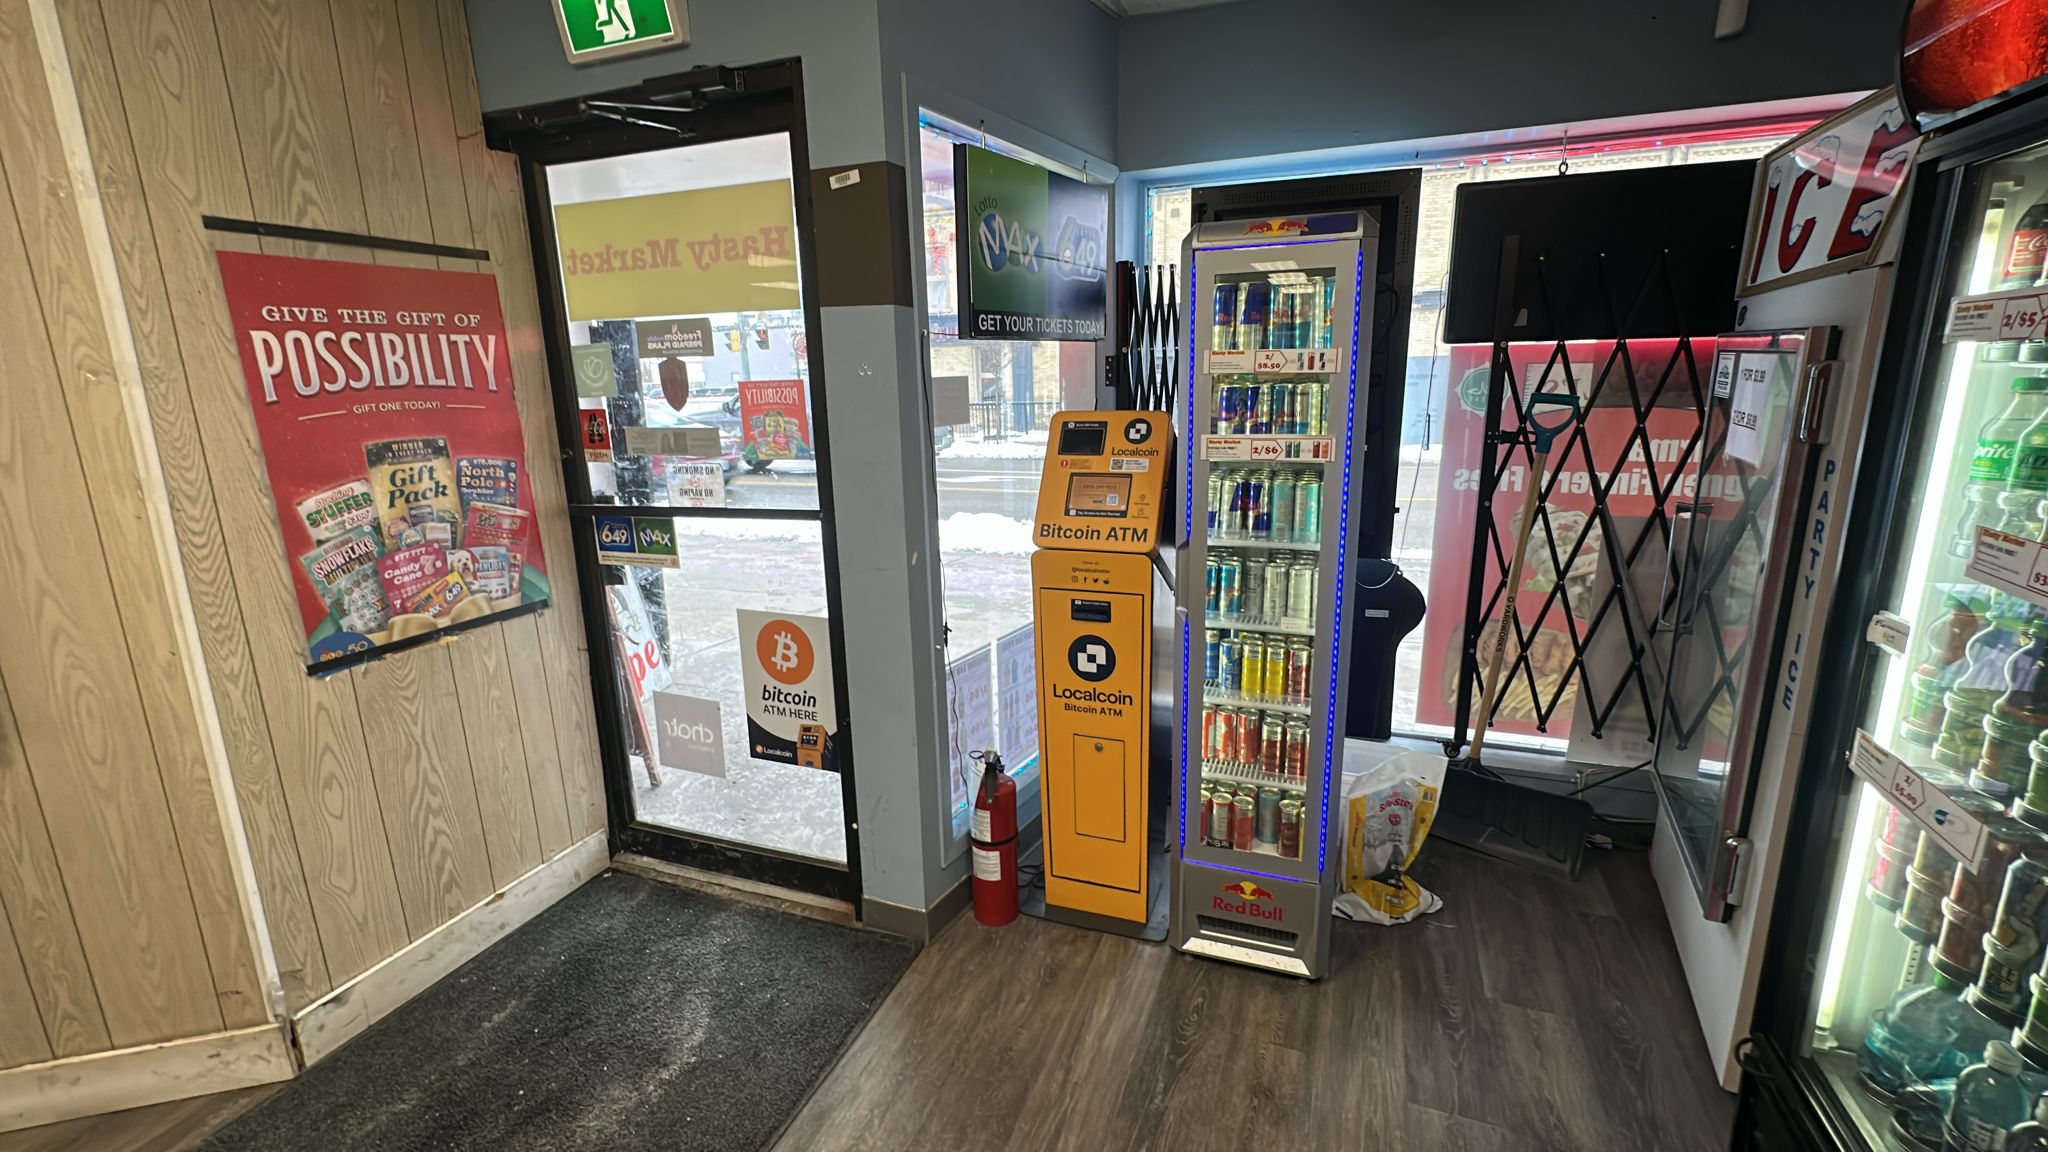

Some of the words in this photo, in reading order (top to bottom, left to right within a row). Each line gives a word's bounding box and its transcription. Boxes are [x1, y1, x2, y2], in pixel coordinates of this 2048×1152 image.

[1750, 106, 1918, 284] ICE
[974, 196, 997, 216] Lotto
[979, 213, 1040, 273] MAX
[261, 305, 328, 323] GIVE
[338, 309, 387, 325] THE
[396, 311, 446, 326] GIFT
[454, 313, 481, 327] OF
[978, 314, 1002, 331] GET
[1003, 315, 1034, 332] YOUR
[1035, 317, 1073, 333] TICKETS
[1075, 319, 1104, 335] TODAY!
[2003, 311, 2038, 331] 2/$5
[250, 330, 497, 403] POSSIBILITY
[354, 403, 378, 414] GIFT
[380, 402, 402, 412] ONE
[403, 401, 440, 411] TODAY!
[391, 441, 424, 451] WINNER
[1112, 447, 1159, 457] Localcoin
[1252, 446, 1279, 455] 2/$6
[390, 465, 437, 488] Gift
[461, 466, 504, 478] North
[461, 477, 494, 487] Pole
[388, 480, 448, 508] Pack
[306, 491, 373, 528] STUFFER
[602, 523, 628, 543] 649
[640, 528, 672, 547] MAX
[1040, 523, 1101, 541] Bitcoin
[1105, 526, 1149, 542] ATM
[1804, 459, 1836, 599] PARTY
[312, 536, 378, 578] SNOWFLAKE
[384, 560, 420, 579] Candy
[394, 570, 422, 586] Cane
[1496, 603, 1513, 653] YARDWORKS
[629, 640, 661, 698] pe
[1782, 634, 1801, 711] ICE
[762, 685, 817, 709] bitcoin
[1053, 683, 1133, 706] Localcoin
[763, 705, 787, 717] ATM
[789, 708, 818, 722] HERE
[1064, 702, 1097, 714] Bitcoin
[1100, 705, 1123, 717] ATM
[764, 746, 793, 758] Localcoin
[1212, 896, 1247, 914] Red
[1249, 903, 1283, 921] Bull
